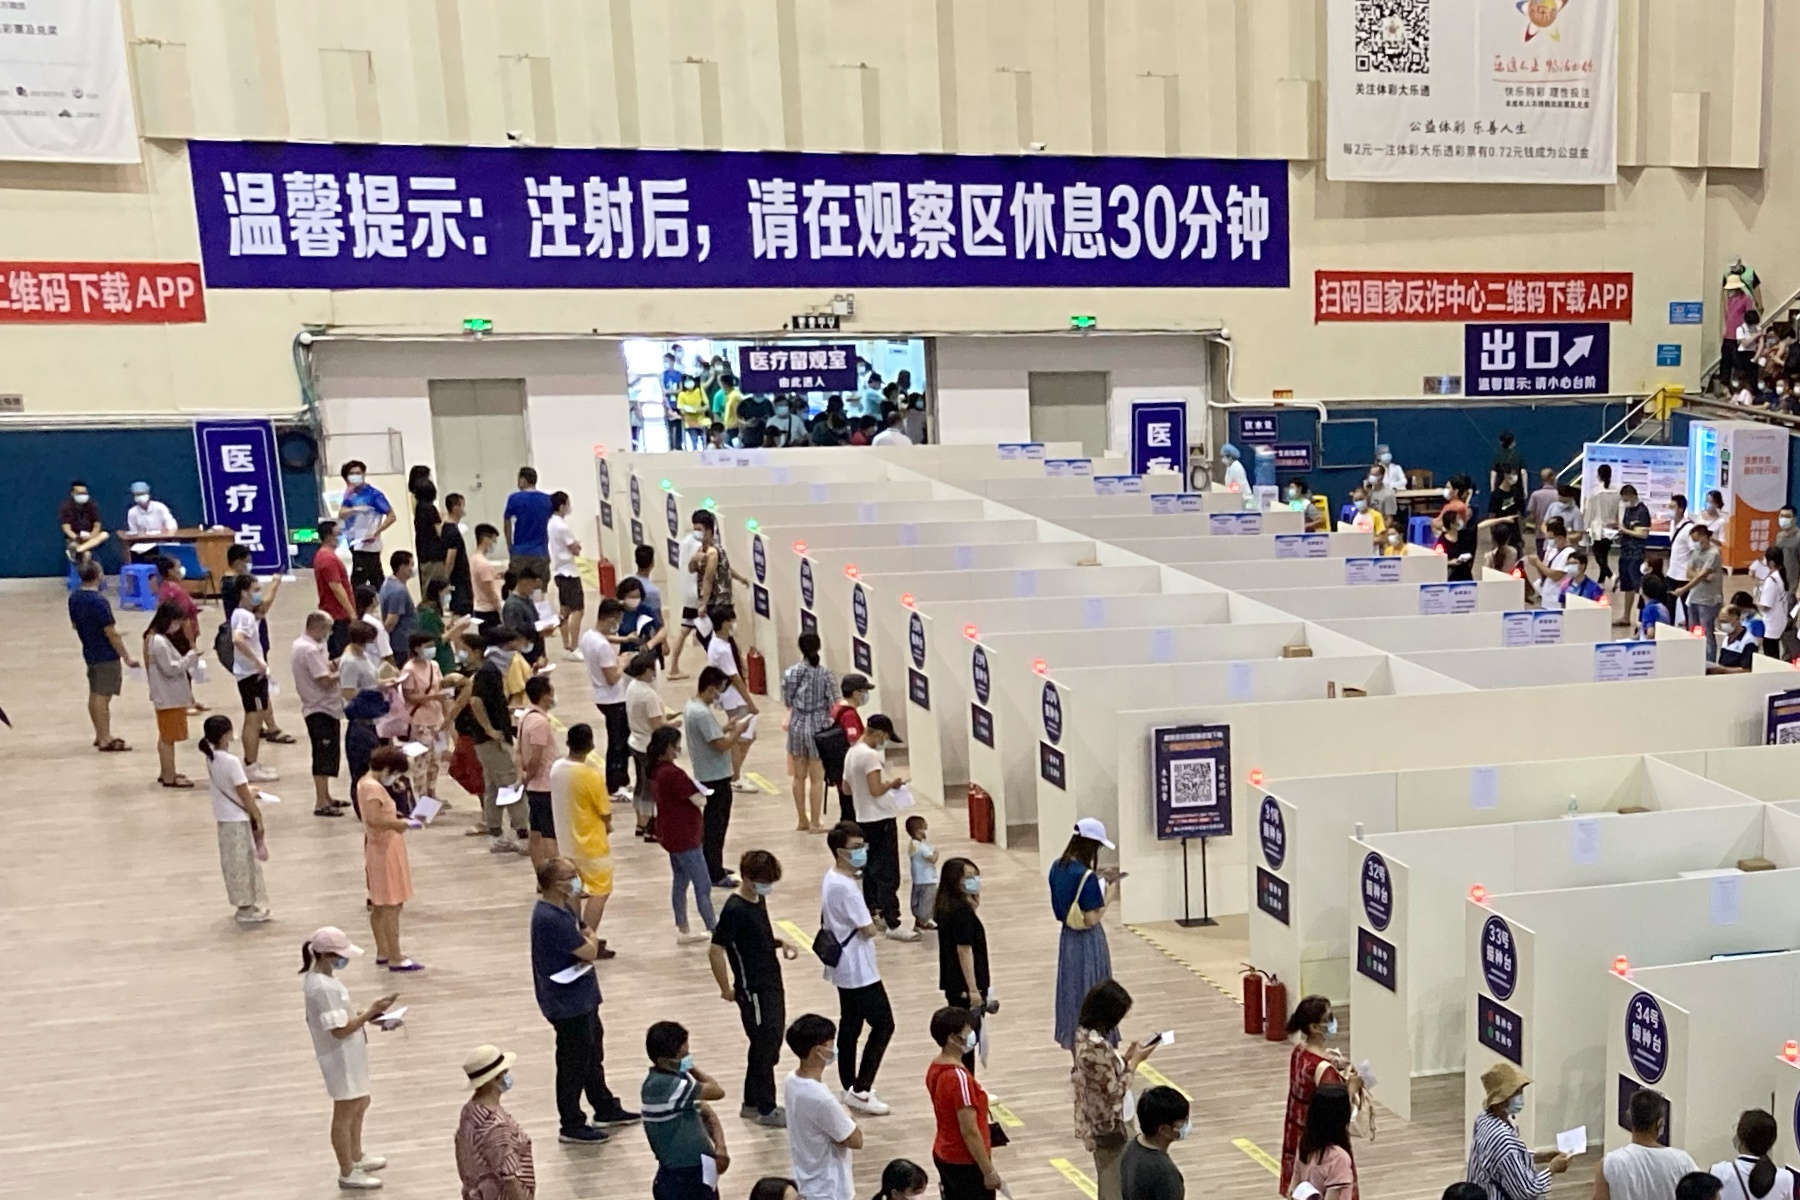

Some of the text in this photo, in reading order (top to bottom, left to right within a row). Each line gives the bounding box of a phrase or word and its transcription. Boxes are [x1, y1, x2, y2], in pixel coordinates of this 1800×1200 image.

[1355, 83, 1430, 97] 关注体彩大乐透
[1320, 278, 1629, 316] 扫码国家反诈中心二维码下载APP
[750, 350, 847, 371] 医疗留观室
[1481, 328, 1560, 371] 出口
[220, 443, 265, 552] 医疗点
[1488, 924, 1510, 949] 33号
[1634, 1001, 1660, 1029] 34号
[1631, 1024, 1662, 1054] 接种台
